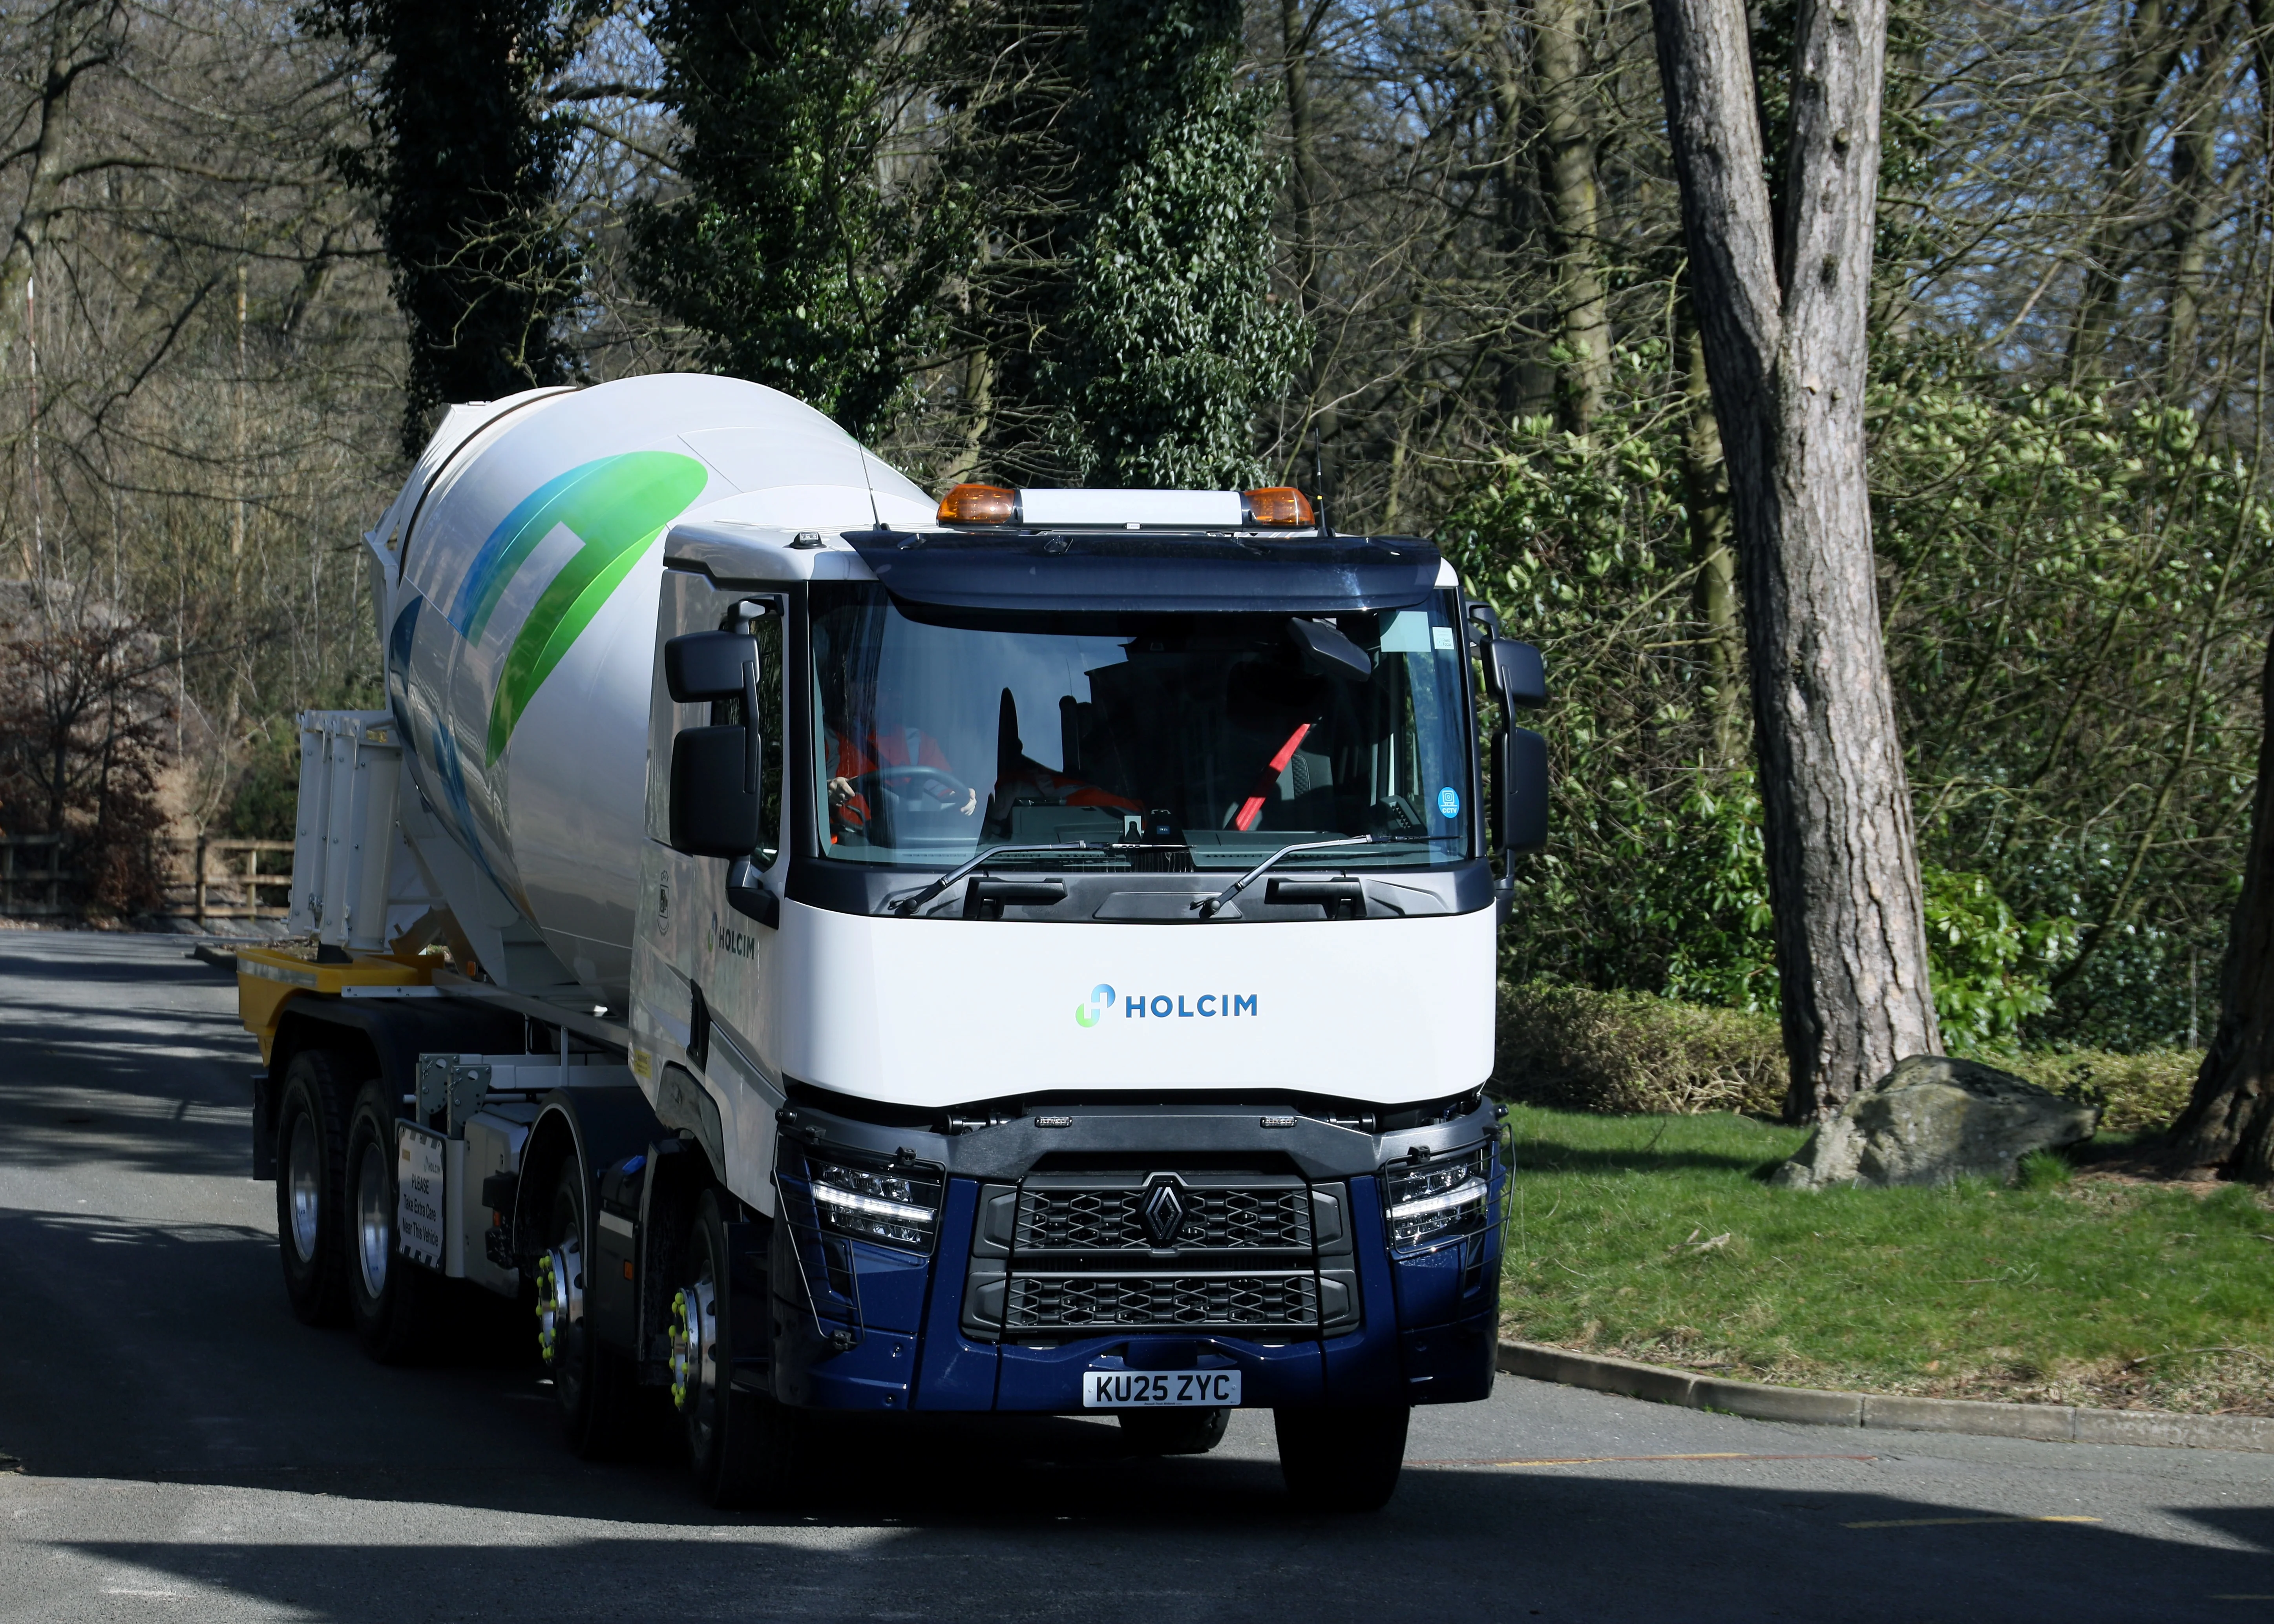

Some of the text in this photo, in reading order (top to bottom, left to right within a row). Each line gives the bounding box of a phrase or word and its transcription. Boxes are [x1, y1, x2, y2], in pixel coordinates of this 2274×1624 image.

[719, 926, 755, 960] HOLCIM
[1125, 994, 1257, 1018] HOLCIM
[428, 1162, 440, 1175] HOLCIM
[411, 1173, 429, 1194] PLEASE
[404, 1193, 436, 1222] Take Extra Care
[402, 1217, 438, 1247] Near This Vehicle
[1096, 1374, 1230, 1402] KU25 ZYC
